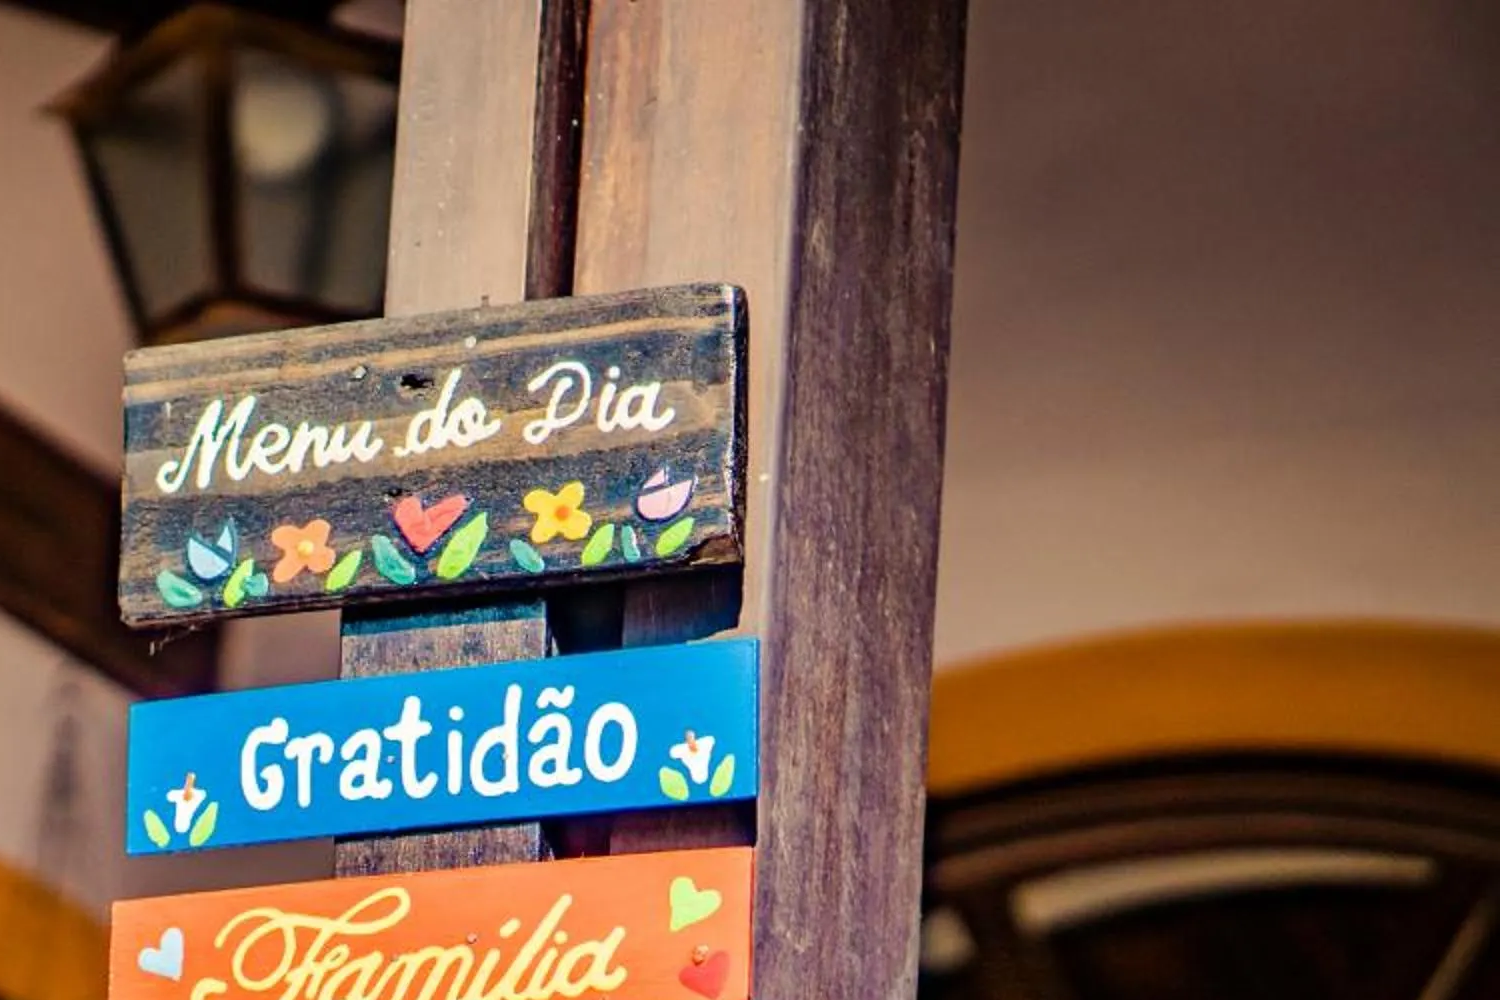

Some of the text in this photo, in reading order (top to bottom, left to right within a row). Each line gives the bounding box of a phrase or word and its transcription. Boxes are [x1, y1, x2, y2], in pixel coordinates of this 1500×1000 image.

[156, 360, 675, 494] Menu do Dia
[240, 684, 638, 811] Gratidão
